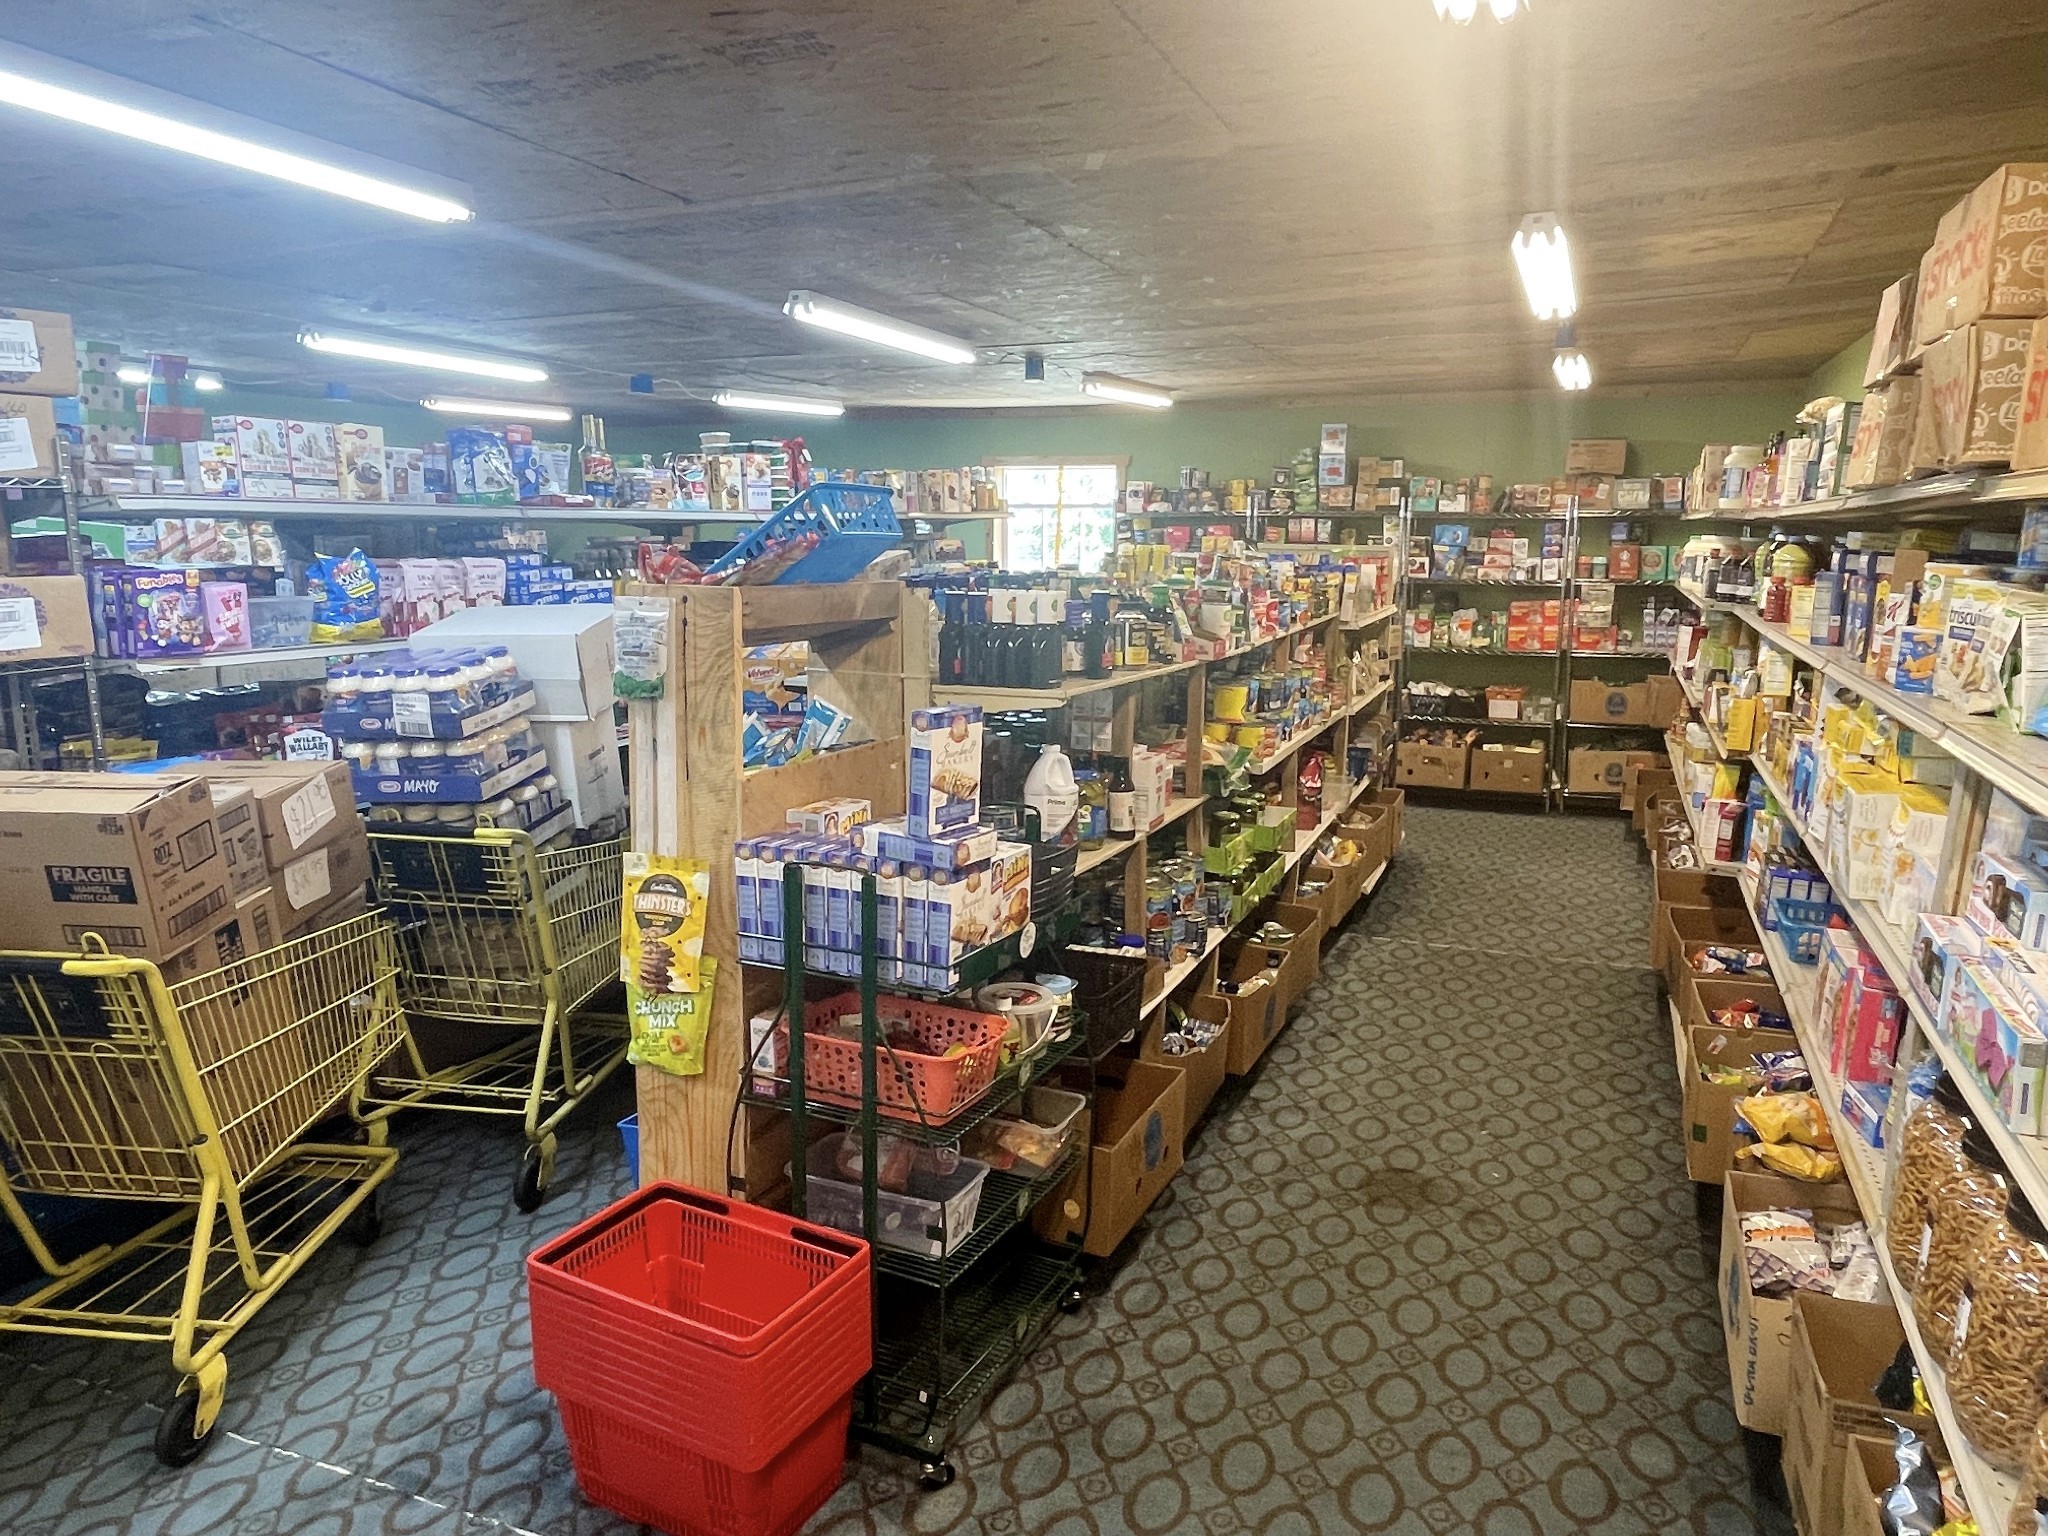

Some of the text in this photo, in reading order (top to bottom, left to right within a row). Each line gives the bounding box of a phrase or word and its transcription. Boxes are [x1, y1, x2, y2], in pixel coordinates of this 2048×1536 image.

[404, 779, 440, 794] MAYO
[51, 866, 127, 884] FRAGILE
[648, 1013, 677, 1028] MIX
